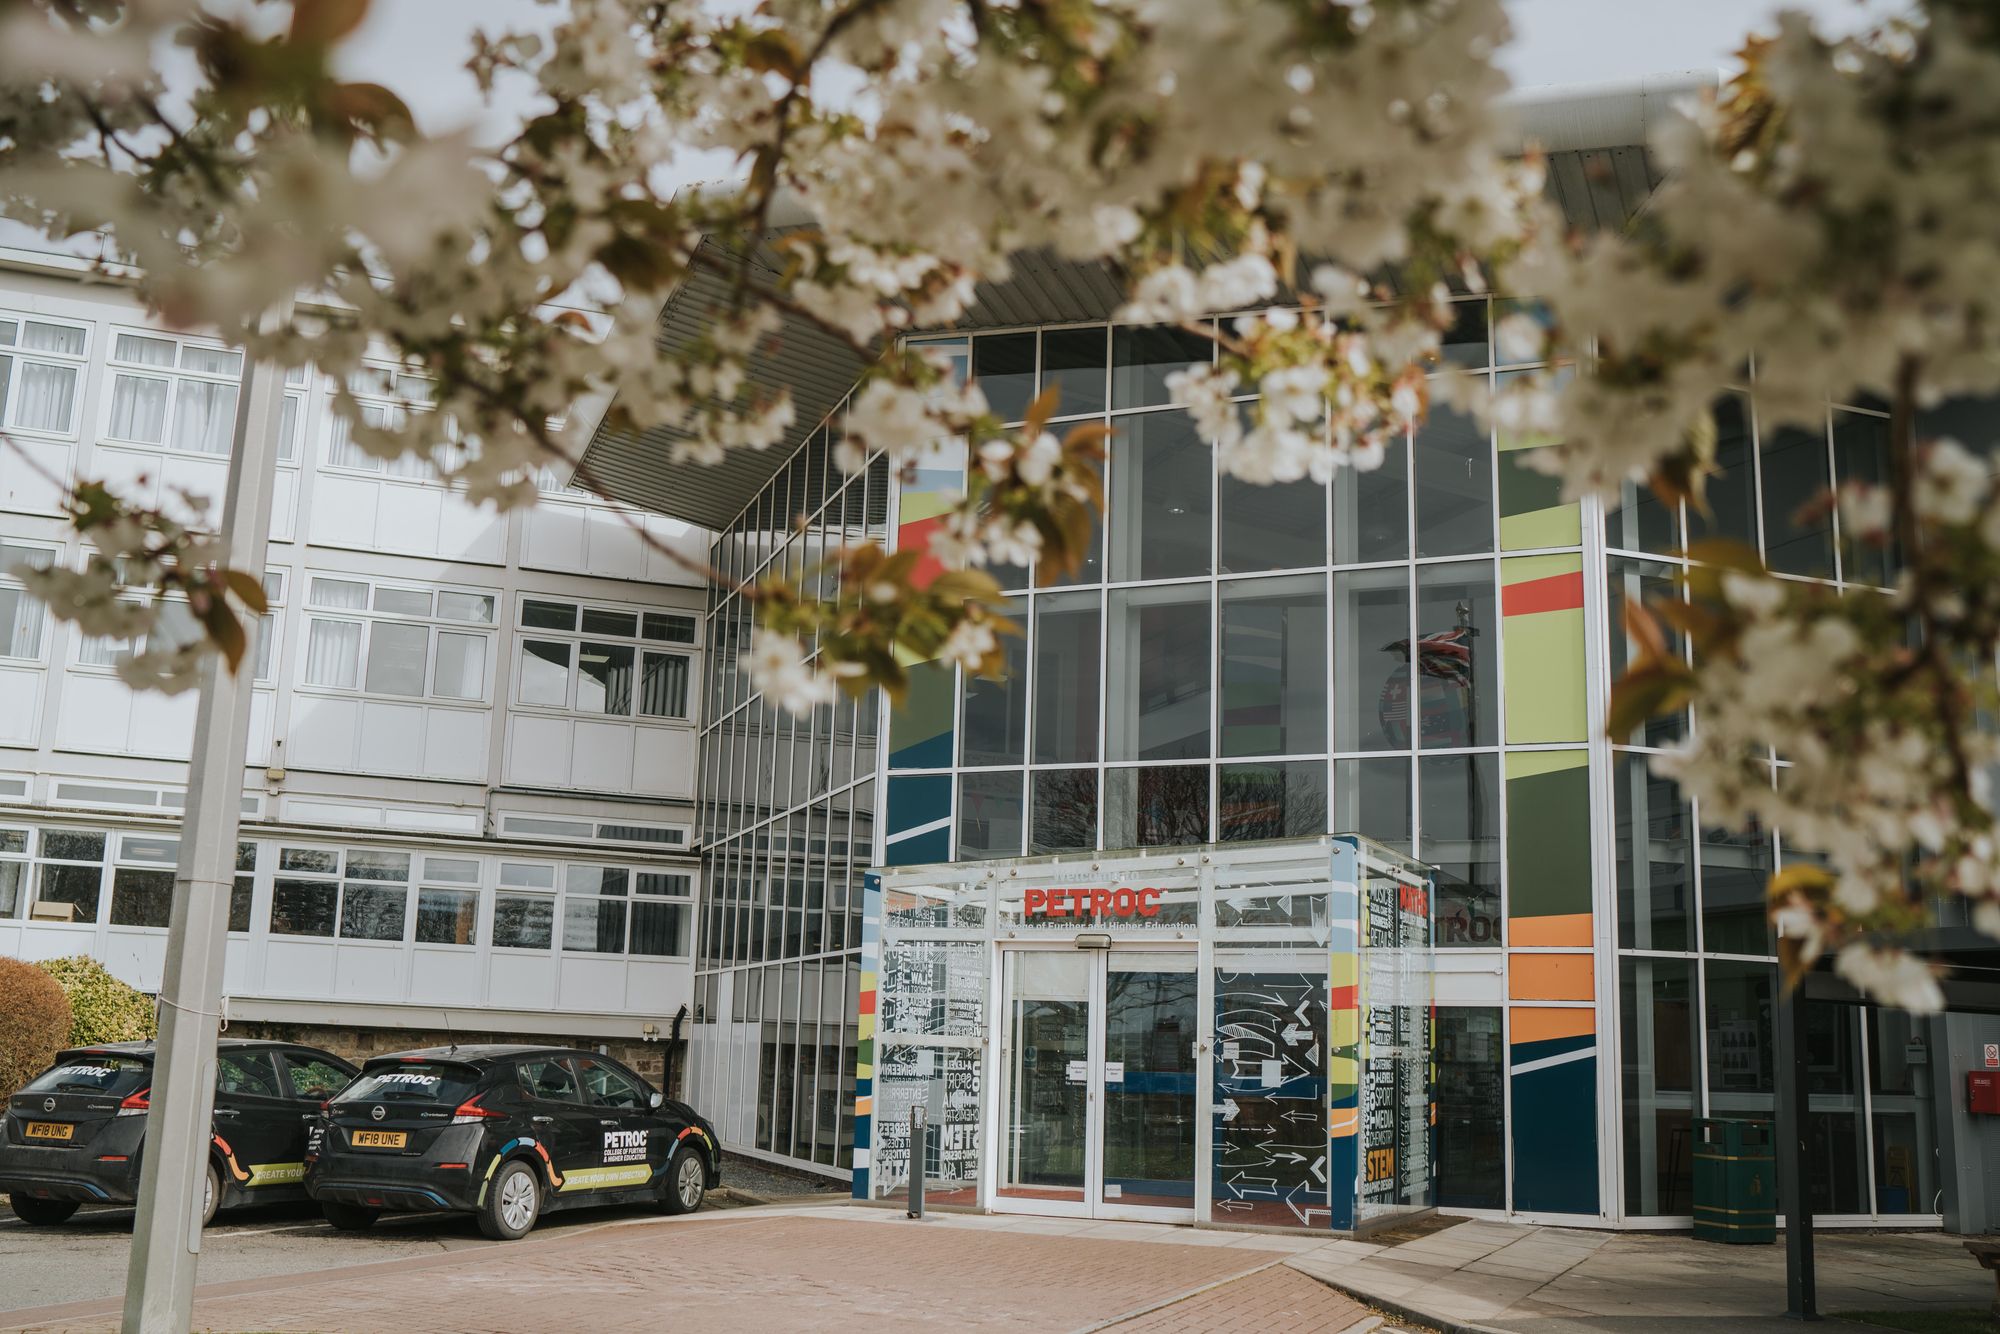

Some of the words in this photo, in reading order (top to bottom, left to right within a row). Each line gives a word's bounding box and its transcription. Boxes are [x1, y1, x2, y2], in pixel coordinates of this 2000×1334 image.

[1024, 887, 1161, 917] PETROC
[1400, 882, 1428, 918] MATHS
[1037, 921, 1047, 931] of
[1049, 921, 1086, 931] Further
[1088, 921, 1106, 931] and
[1109, 921, 1143, 931] Higher
[1145, 921, 1196, 931] Education
[376, 1073, 436, 1086] PETROC
[1376, 1072, 1394, 1084] A-LEVELS
[1375, 1087, 1394, 1107] SPORT
[1375, 1110, 1394, 1129] MEDIA
[31, 1123, 50, 1137] WF18
[51, 1125, 68, 1138] UNG
[358, 1132, 379, 1145] WF18
[381, 1134, 401, 1146] UNE
[604, 1130, 647, 1149] PETROC
[603, 1148, 622, 1156] COLLEGE
[624, 1154, 647, 1162] EDUCATION
[1367, 1148, 1394, 1182] STEM
[256, 1169, 285, 1180] CREATE
[567, 1175, 589, 1185] CREATE
[590, 1174, 606, 1183] YOUR
[606, 1173, 619, 1181] OWN
[619, 1170, 647, 1180] DIRECTION
